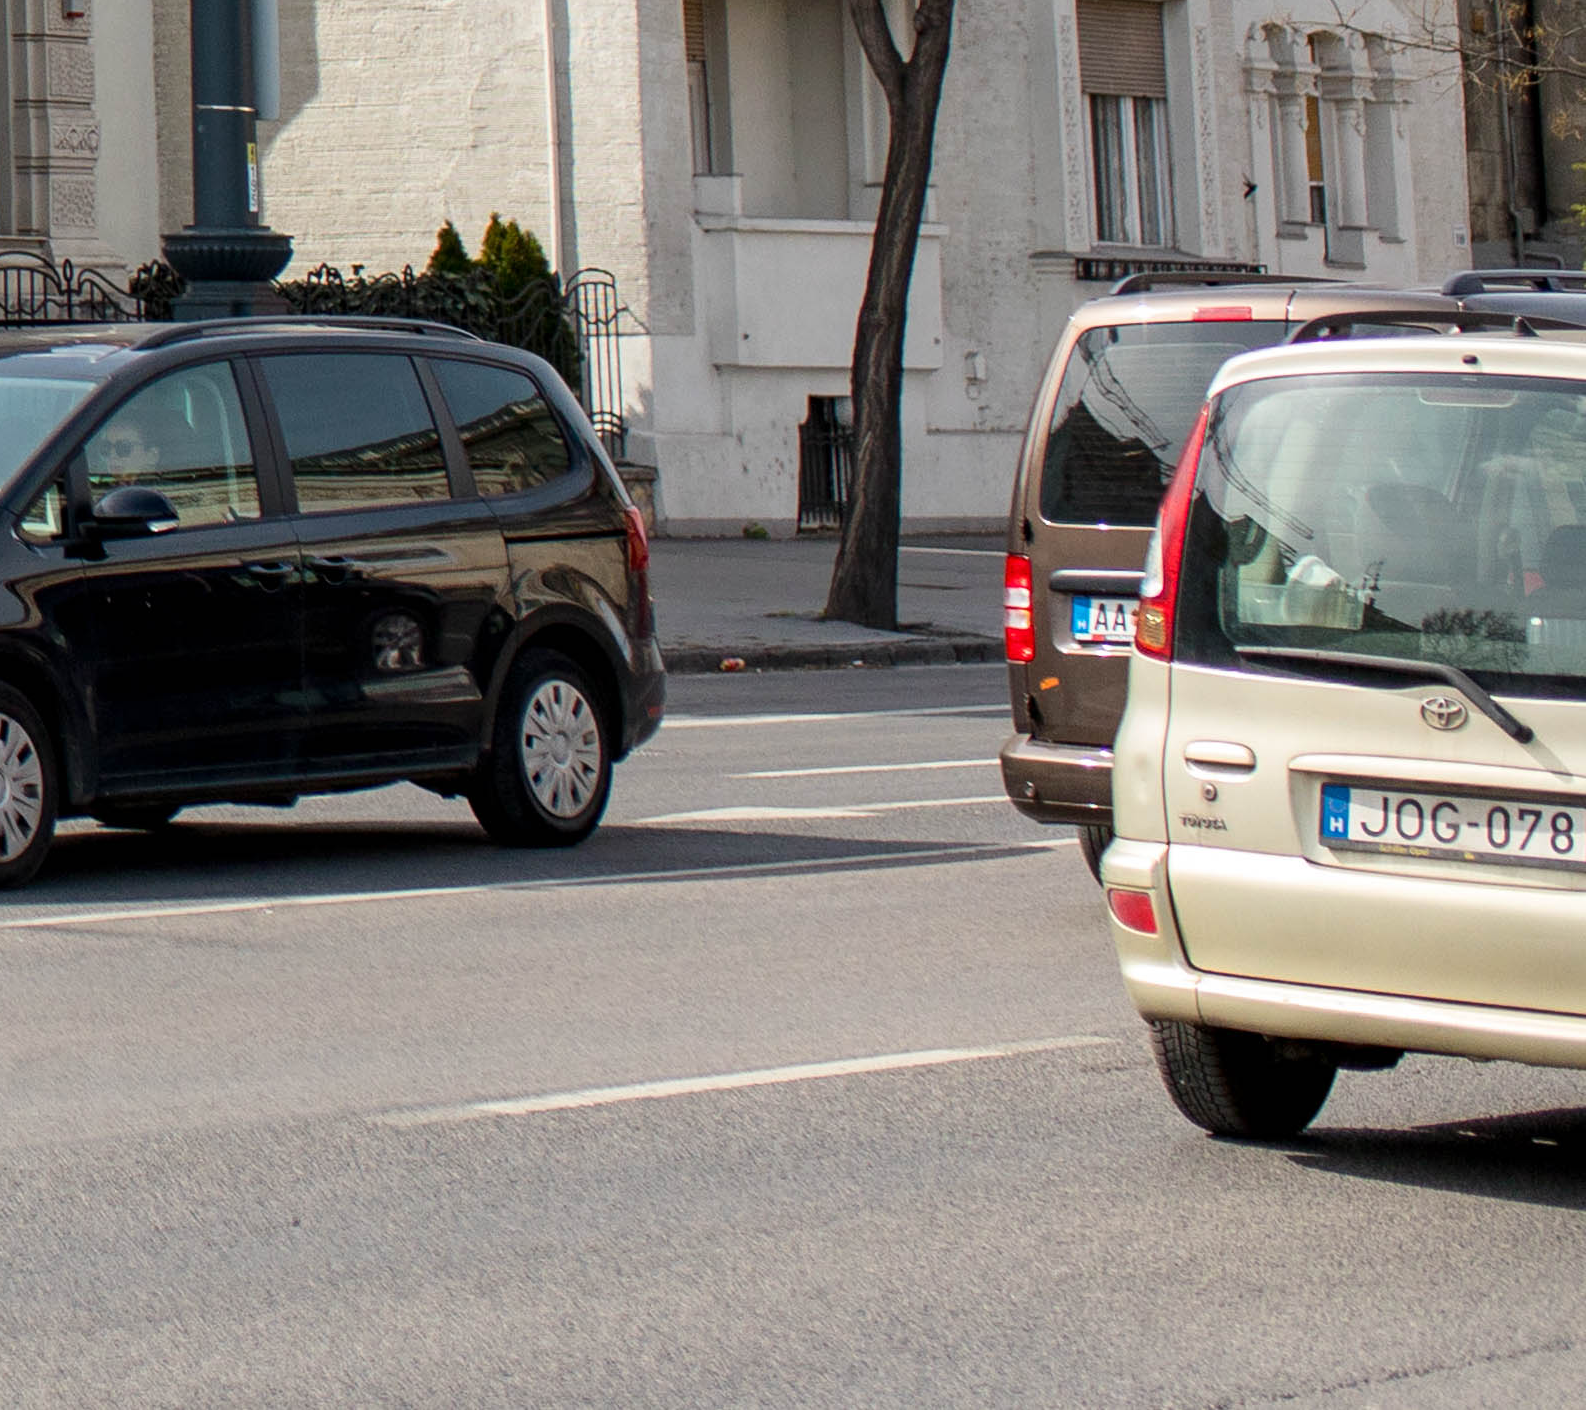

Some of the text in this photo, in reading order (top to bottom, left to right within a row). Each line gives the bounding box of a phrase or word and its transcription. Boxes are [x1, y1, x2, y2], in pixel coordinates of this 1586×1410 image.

[1178, 813, 1228, 831] TOYOTA
[1330, 817, 1344, 833] H
[1360, 796, 1574, 855] JOG-078
